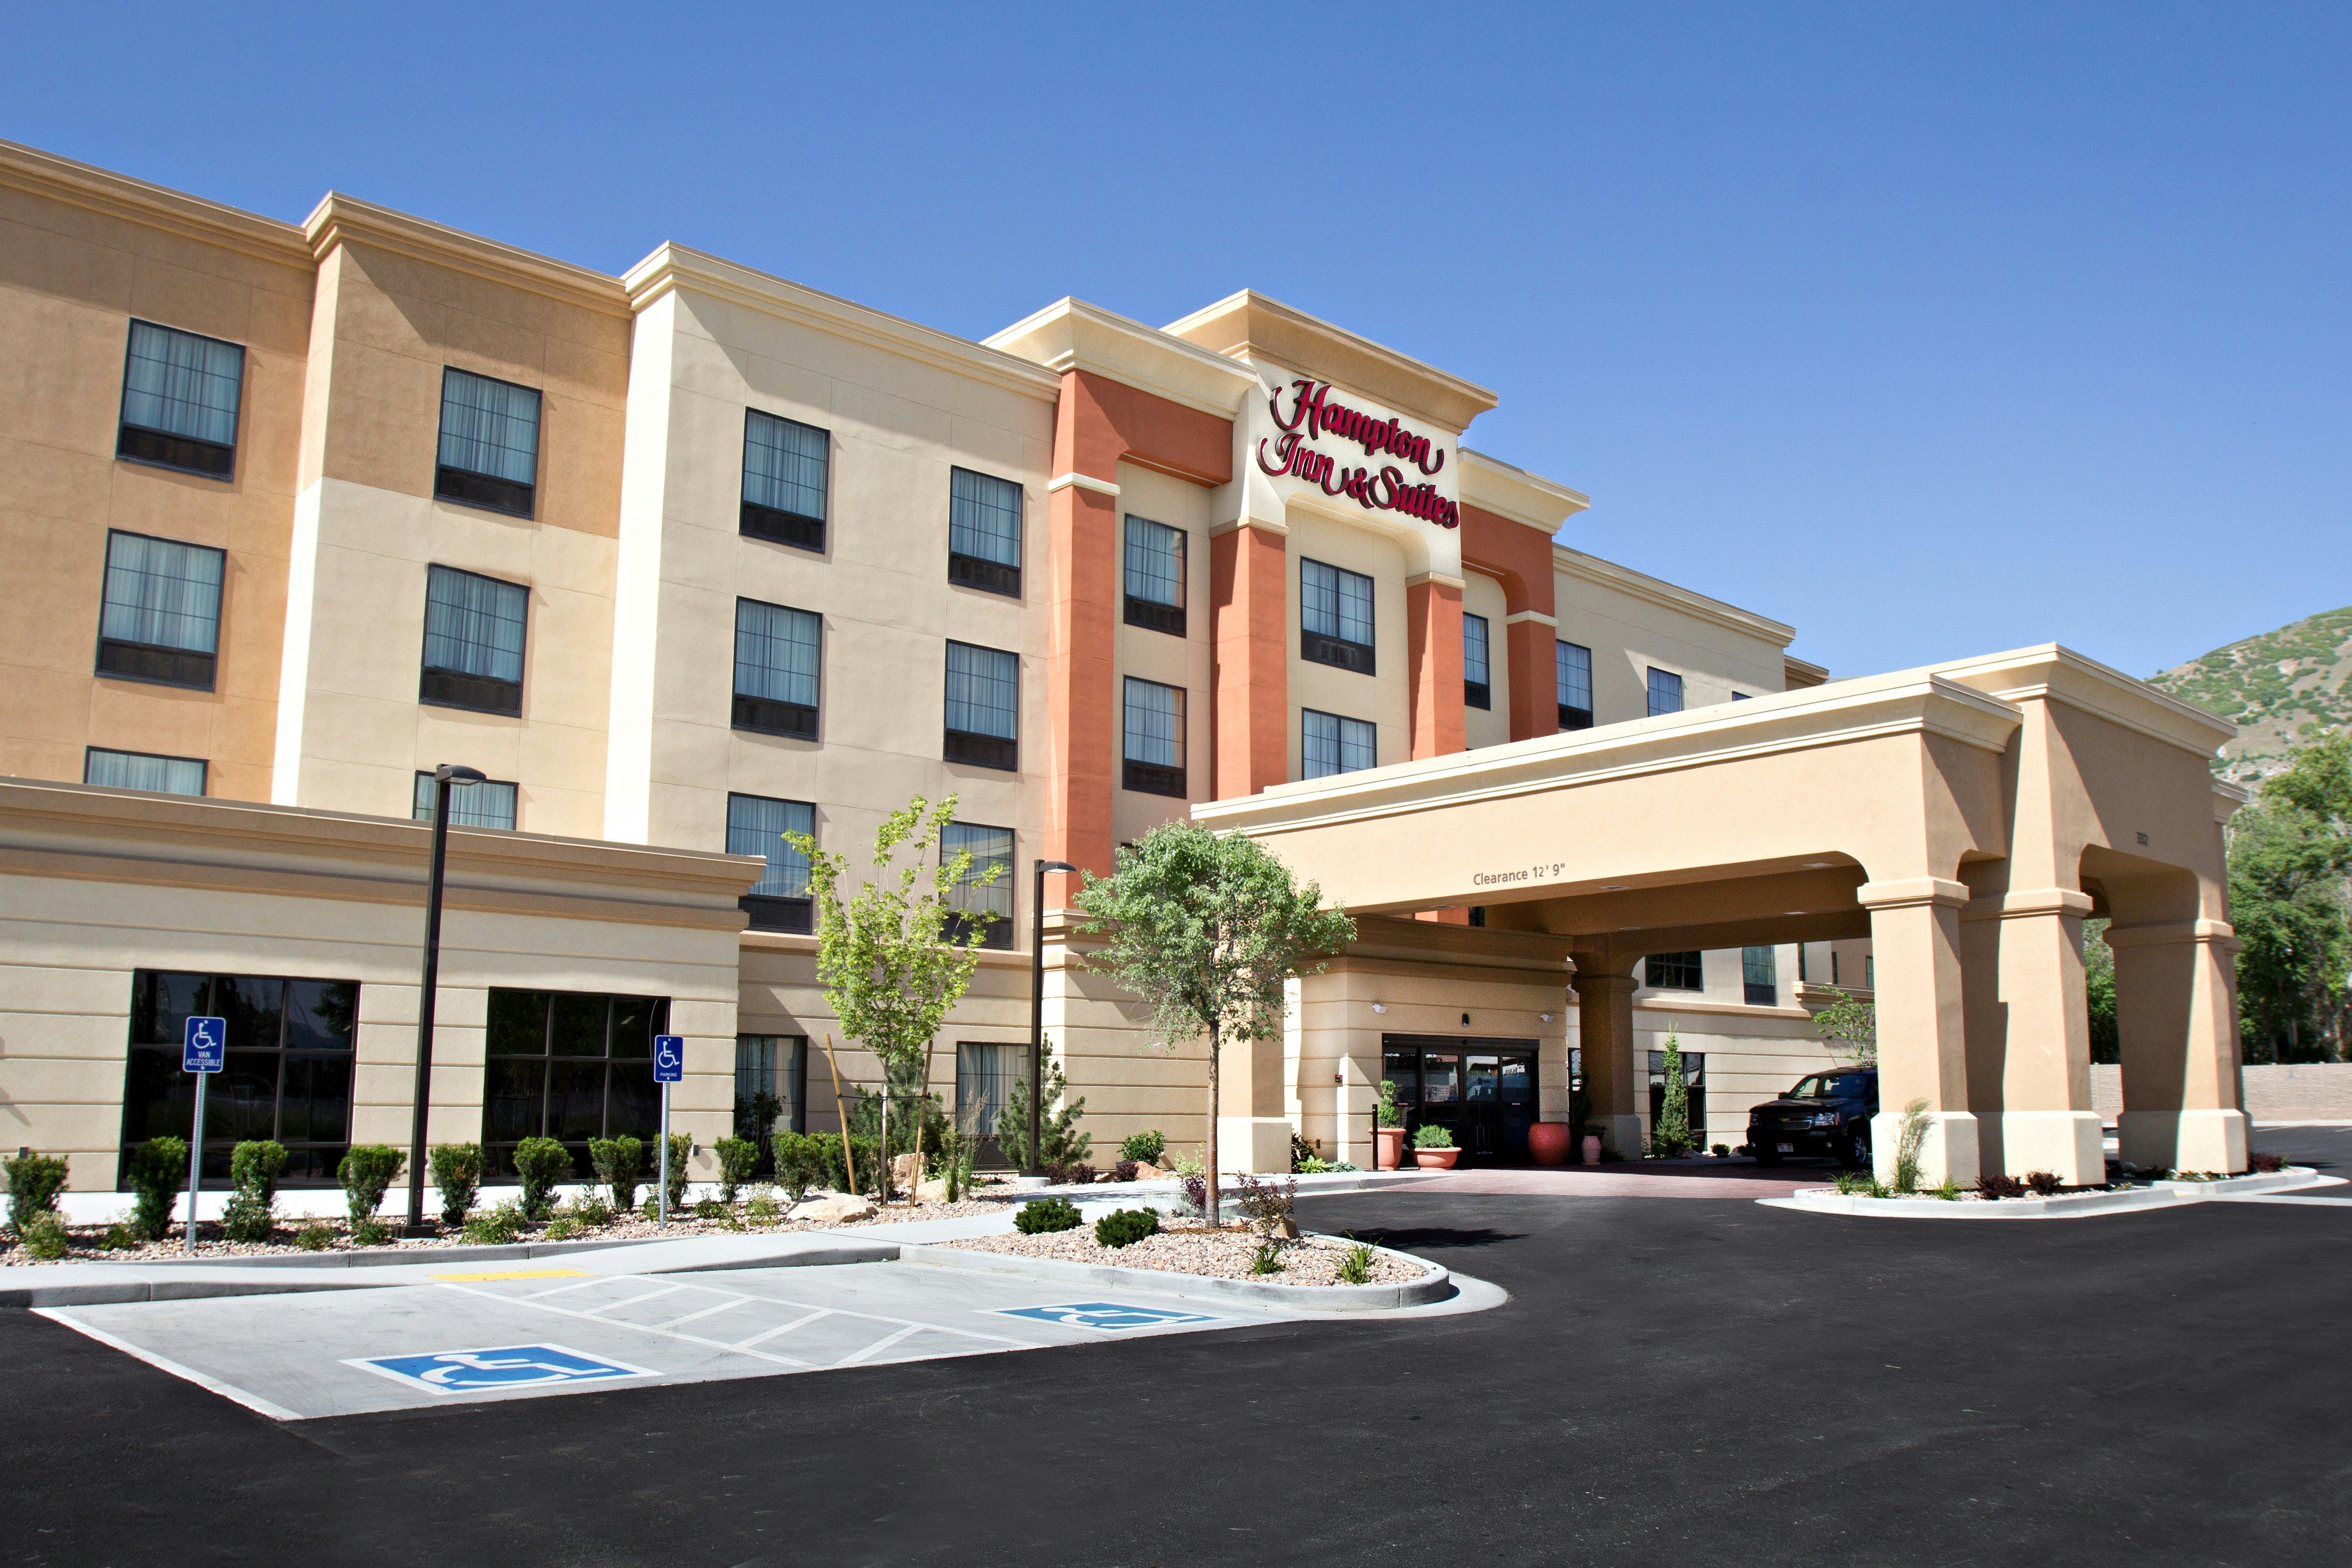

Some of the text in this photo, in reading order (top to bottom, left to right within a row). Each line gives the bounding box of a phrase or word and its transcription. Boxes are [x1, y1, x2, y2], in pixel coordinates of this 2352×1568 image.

[1270, 380, 1444, 475] Hampton
[1255, 433, 1459, 529] Inn & Suites
[1473, 871, 1528, 885] Clearance
